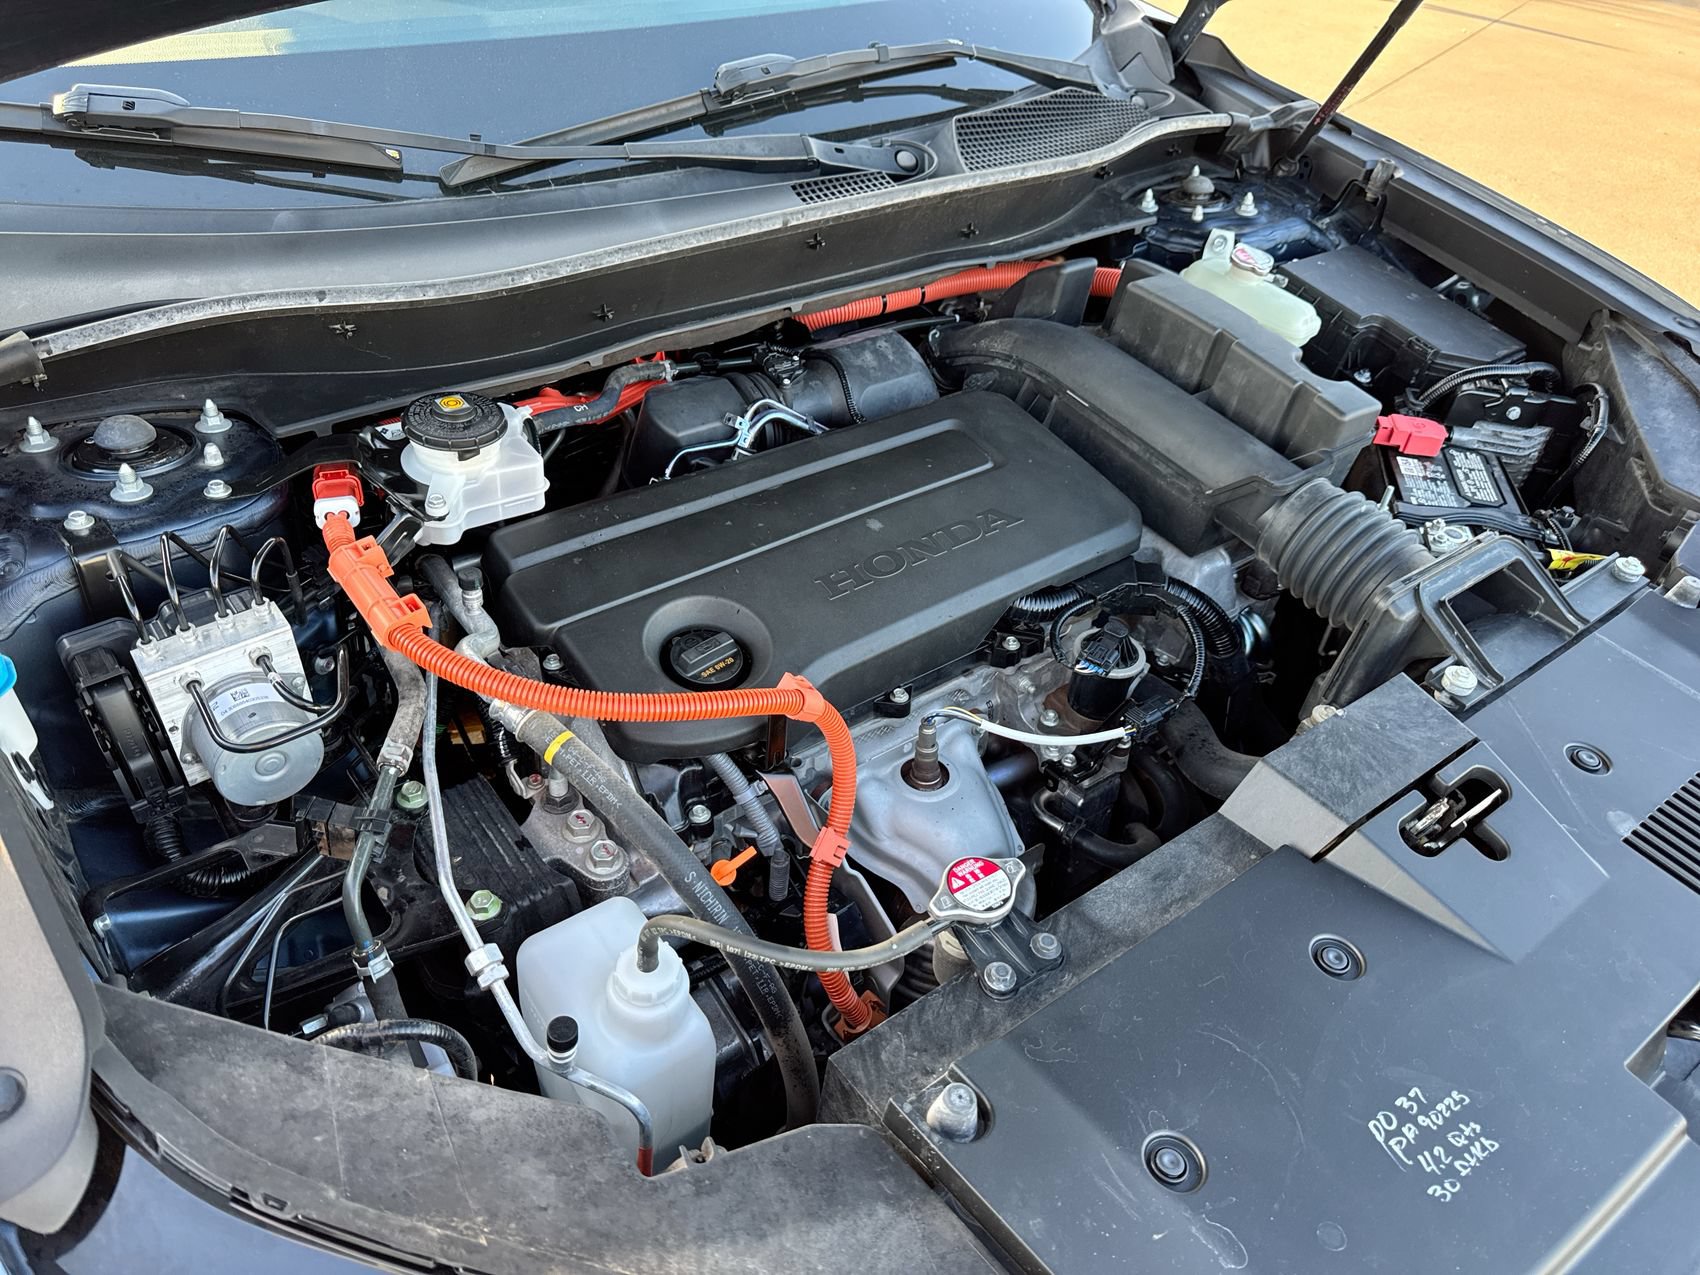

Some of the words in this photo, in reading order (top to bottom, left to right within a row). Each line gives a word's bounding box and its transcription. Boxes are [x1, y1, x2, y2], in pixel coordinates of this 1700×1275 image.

[812, 508, 1025, 600] HONDA
[701, 667, 716, 678] SAE
[759, 955, 777, 966] TPC
[1394, 1086, 1428, 1114] 37
[1417, 1145, 1452, 1175] 4.2
[1427, 1178, 1461, 1202] 30
